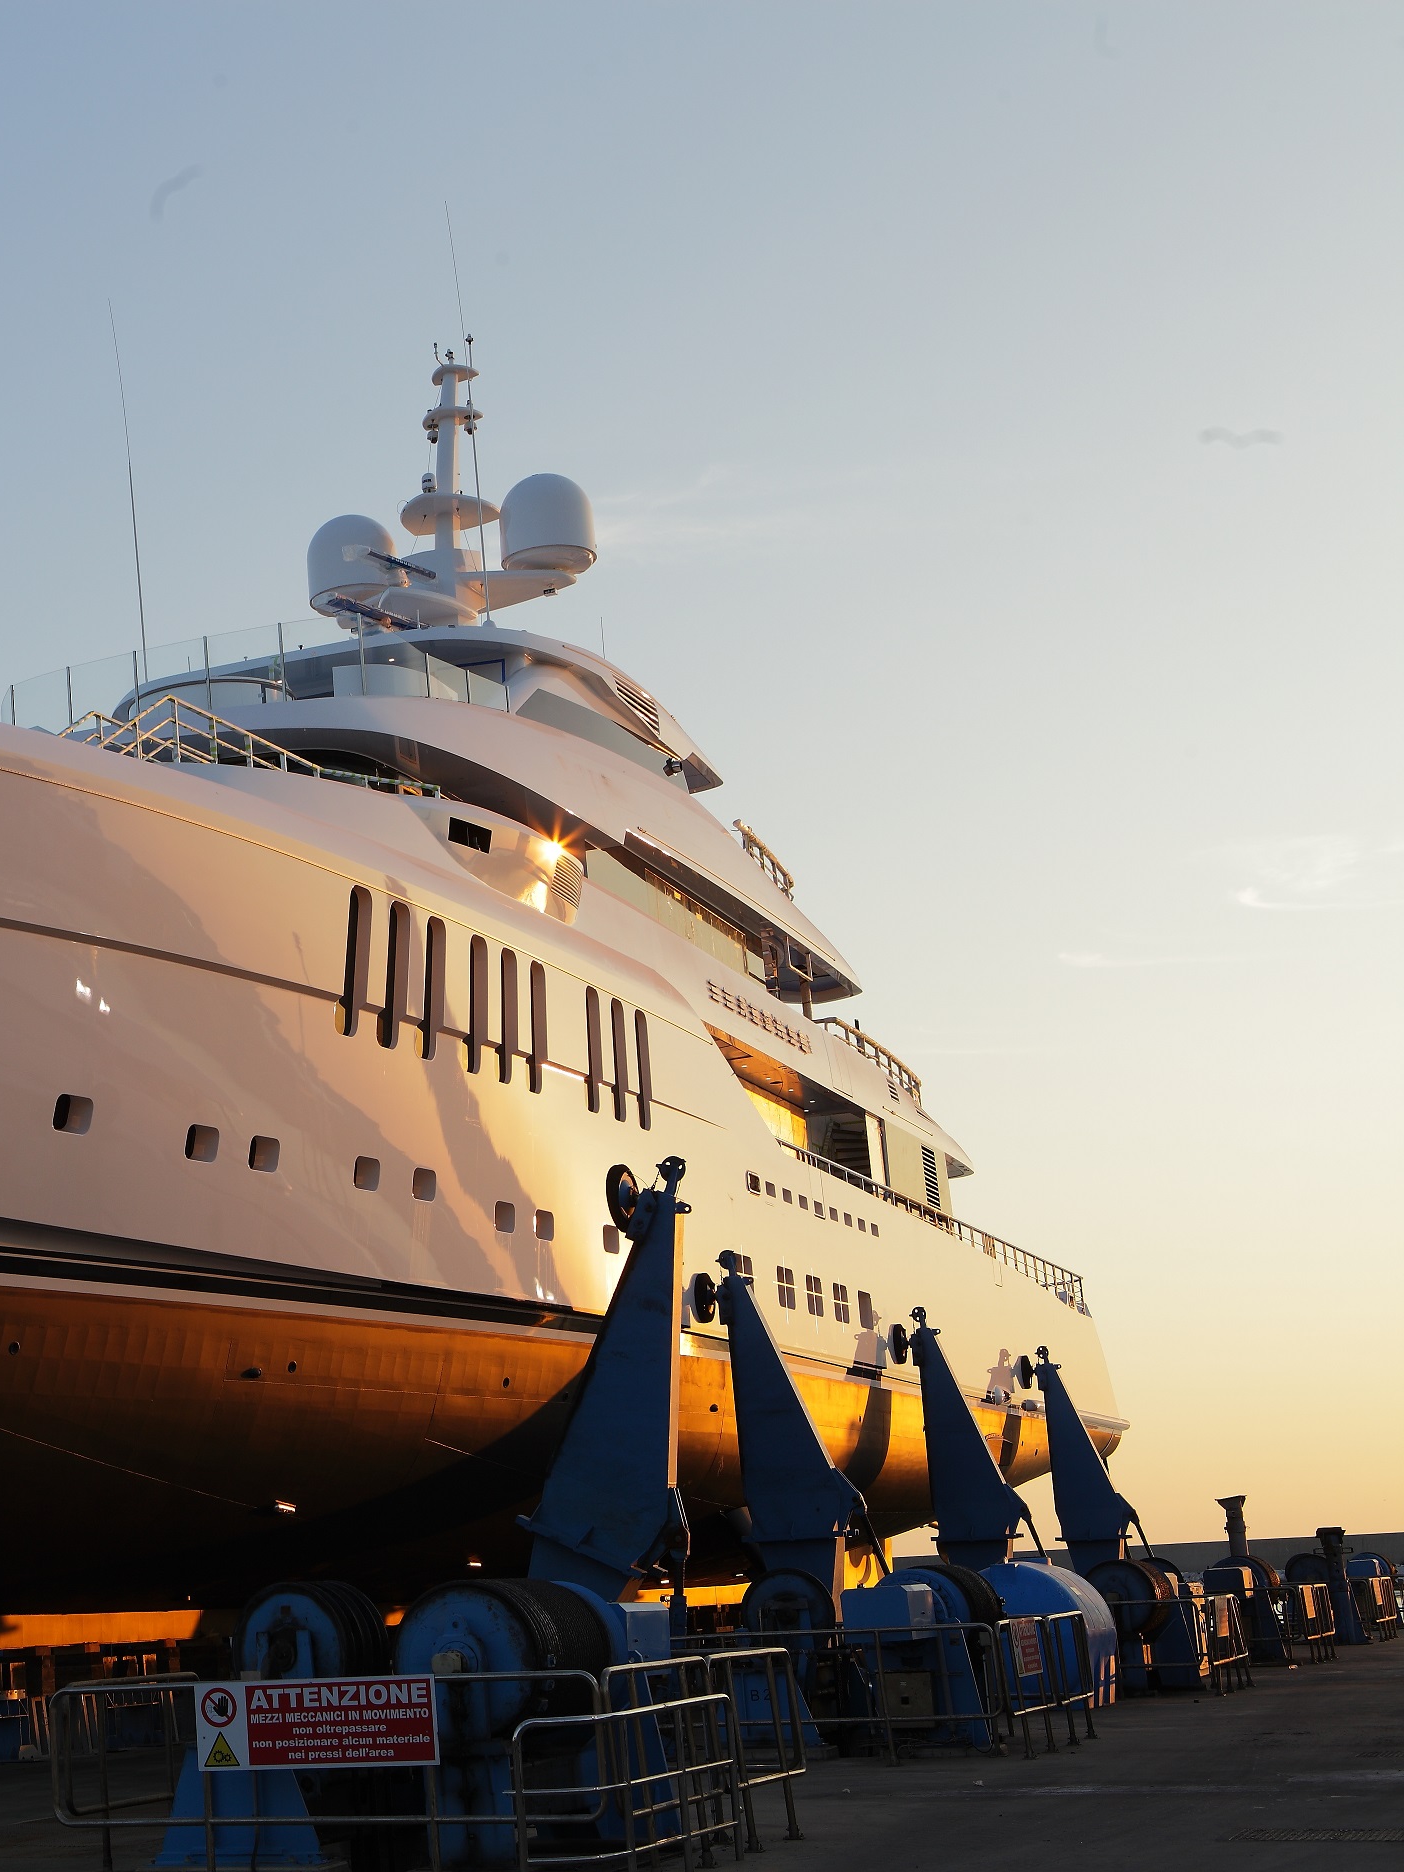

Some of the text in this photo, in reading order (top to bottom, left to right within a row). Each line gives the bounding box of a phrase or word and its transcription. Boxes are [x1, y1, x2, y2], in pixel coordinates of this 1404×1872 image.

[250, 1683, 428, 1709] ATTENZIONE
[250, 1708, 429, 1723] MEZZI MECCANICI IN MOVIMENTO
[316, 1725, 387, 1735] oltrepassare
[253, 1734, 430, 1749] non posizionare alcun materiale
[288, 1748, 394, 1760] nei pressi dell'area
